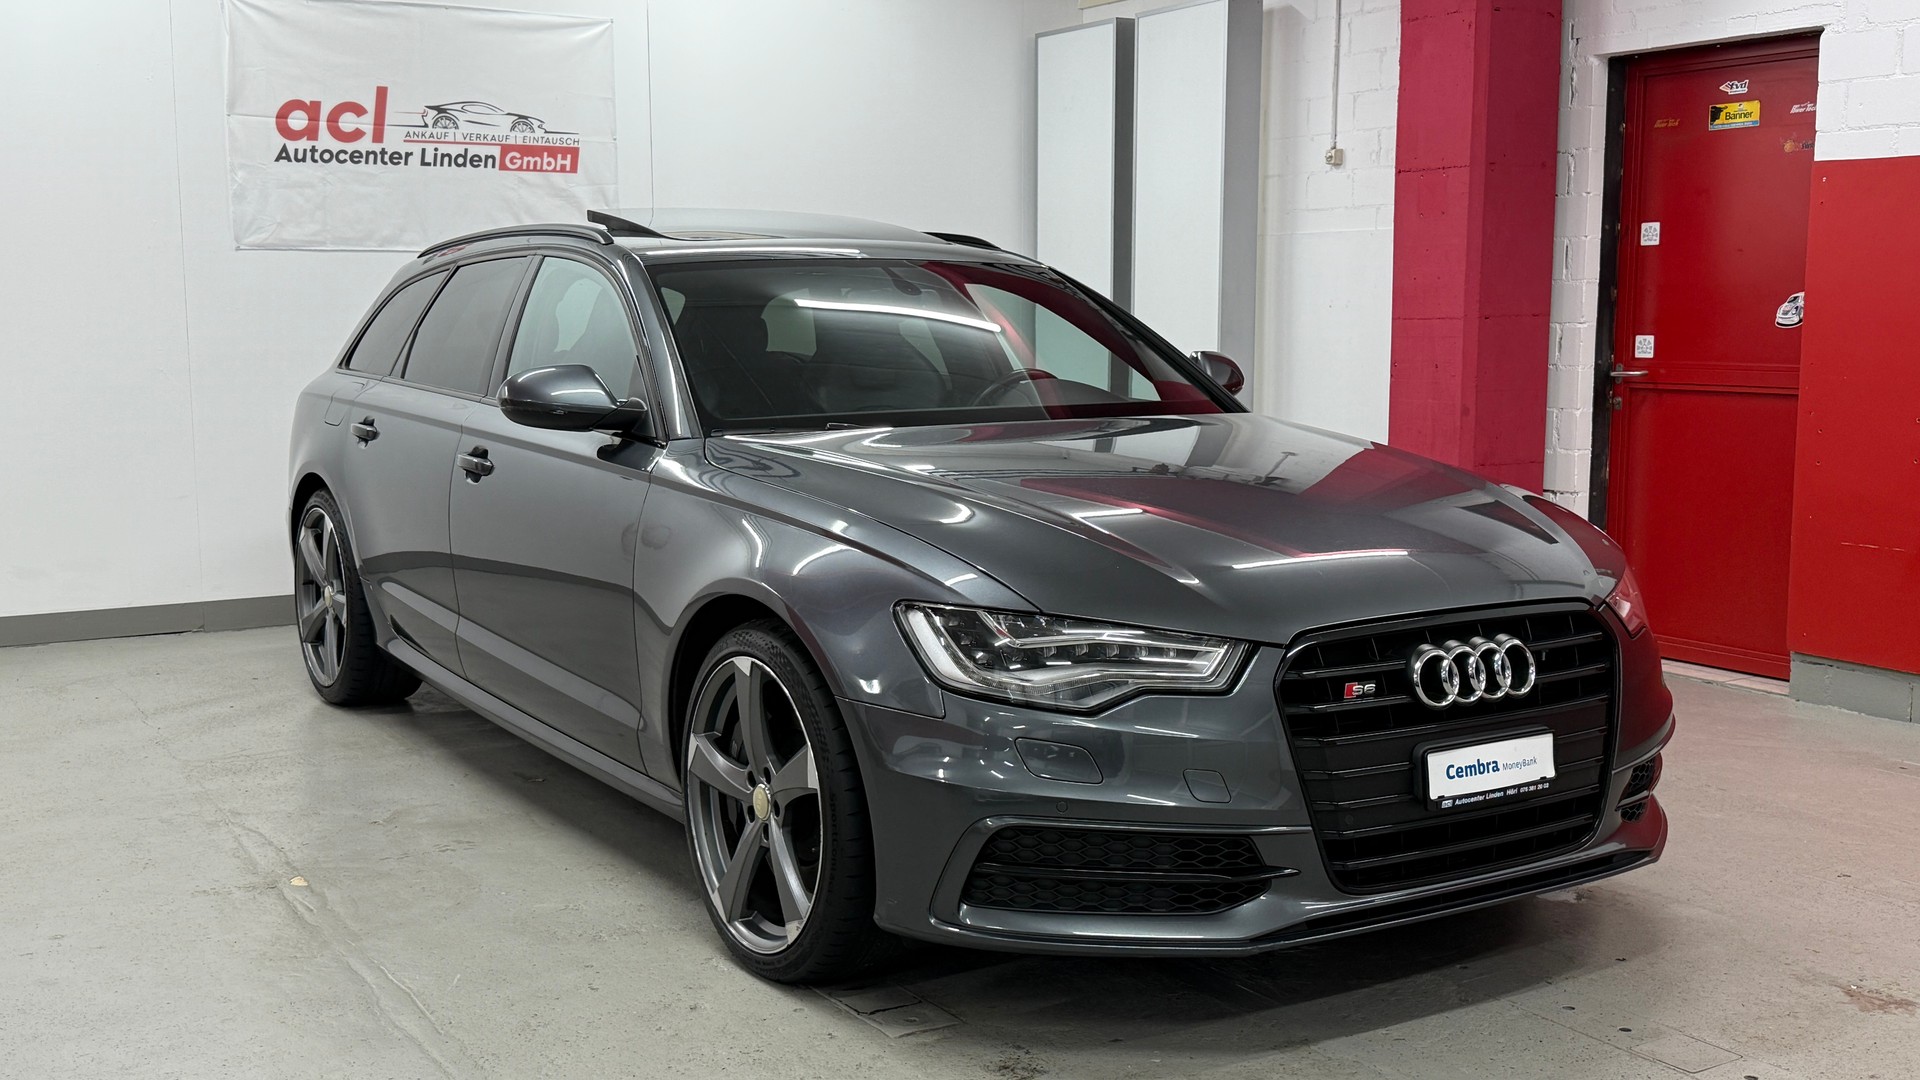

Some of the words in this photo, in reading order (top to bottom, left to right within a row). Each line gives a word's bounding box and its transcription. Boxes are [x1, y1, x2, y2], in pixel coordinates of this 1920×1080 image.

[275, 86, 388, 143] acl
[1725, 111, 1753, 120] Banner
[404, 130, 449, 141] ANKAUF
[462, 132, 511, 143] VERKAUF
[522, 135, 580, 146] EINTAUSCH
[274, 143, 413, 167] Autocenter
[420, 147, 496, 170] Linden
[504, 151, 572, 172] GmbH
[1353, 684, 1376, 695] S6
[1446, 759, 1500, 779] Cembra
[1503, 757, 1537, 770] MoneyBank
[1455, 795, 1485, 805] Autocenter
[1486, 791, 1504, 799] Linden
